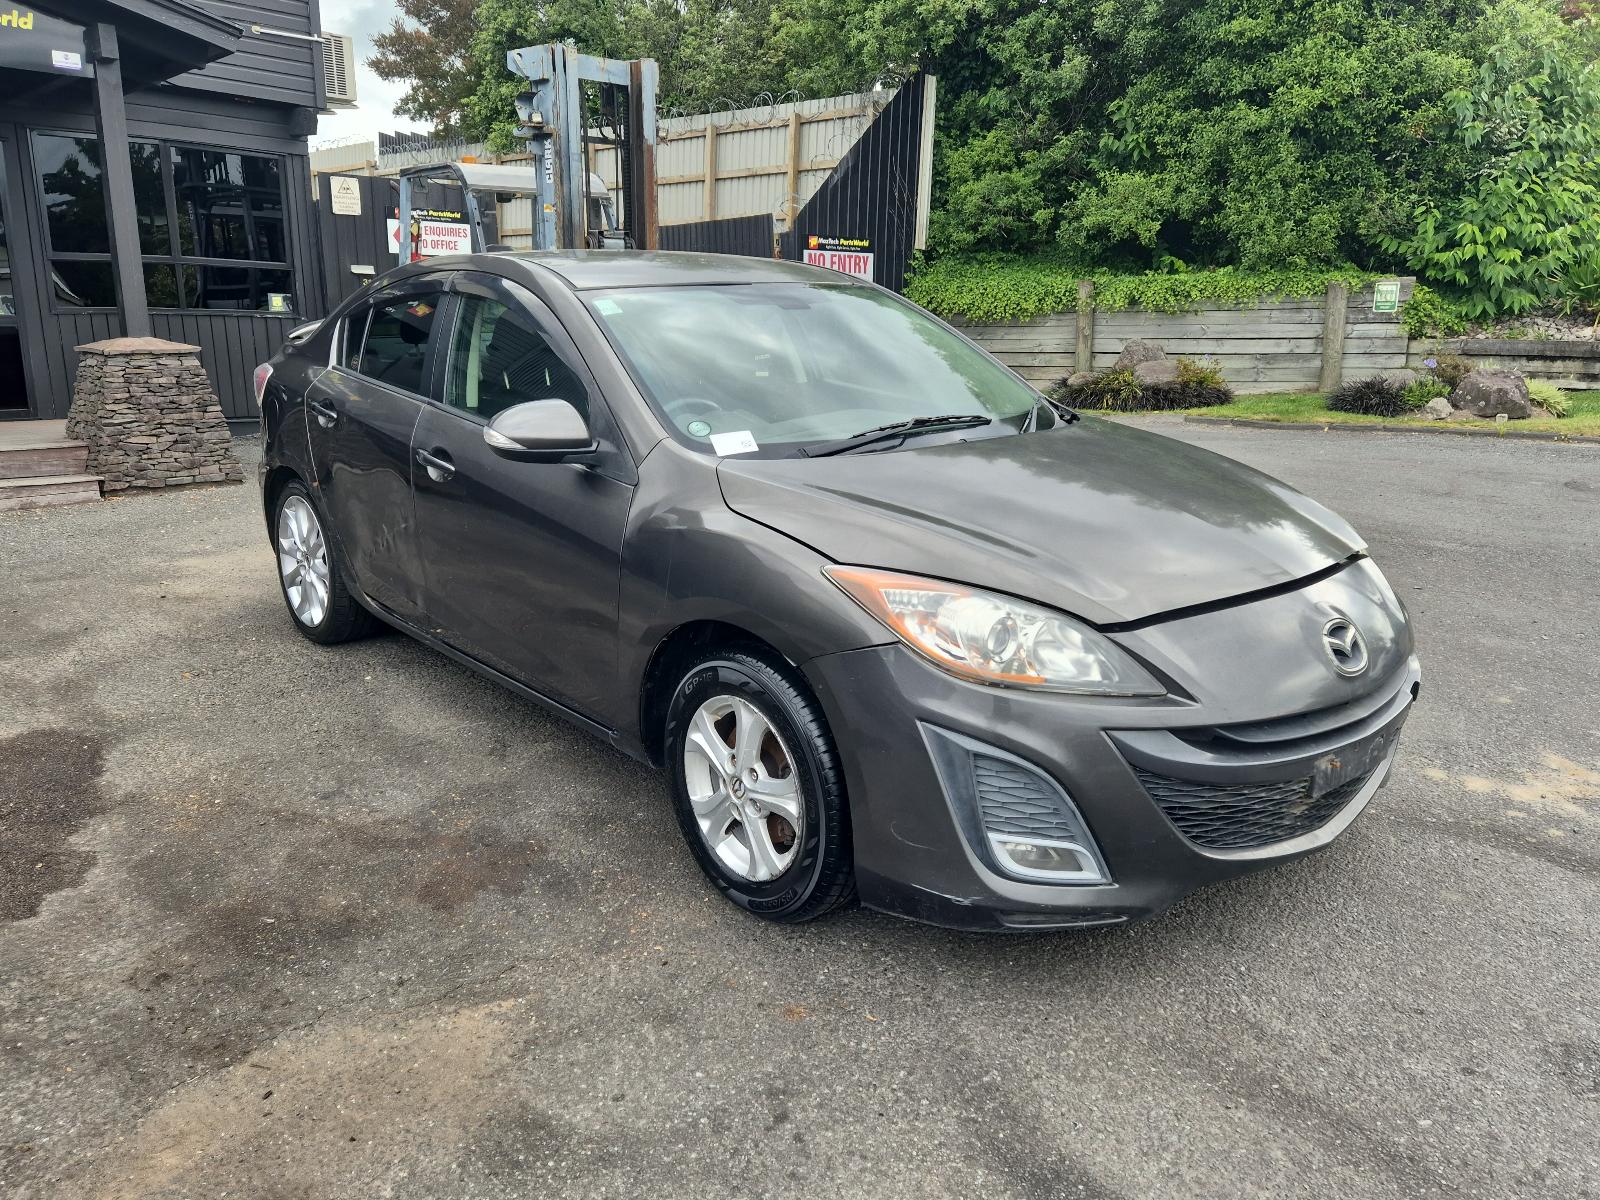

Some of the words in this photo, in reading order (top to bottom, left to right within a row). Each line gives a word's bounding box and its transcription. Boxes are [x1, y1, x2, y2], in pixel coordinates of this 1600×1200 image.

[0, 10, 33, 30] rld
[544, 138, 554, 184] CLARK
[424, 226, 468, 239] ENQUIRIES
[430, 239, 459, 251] OFFICE
[830, 253, 869, 274] ENTRY
